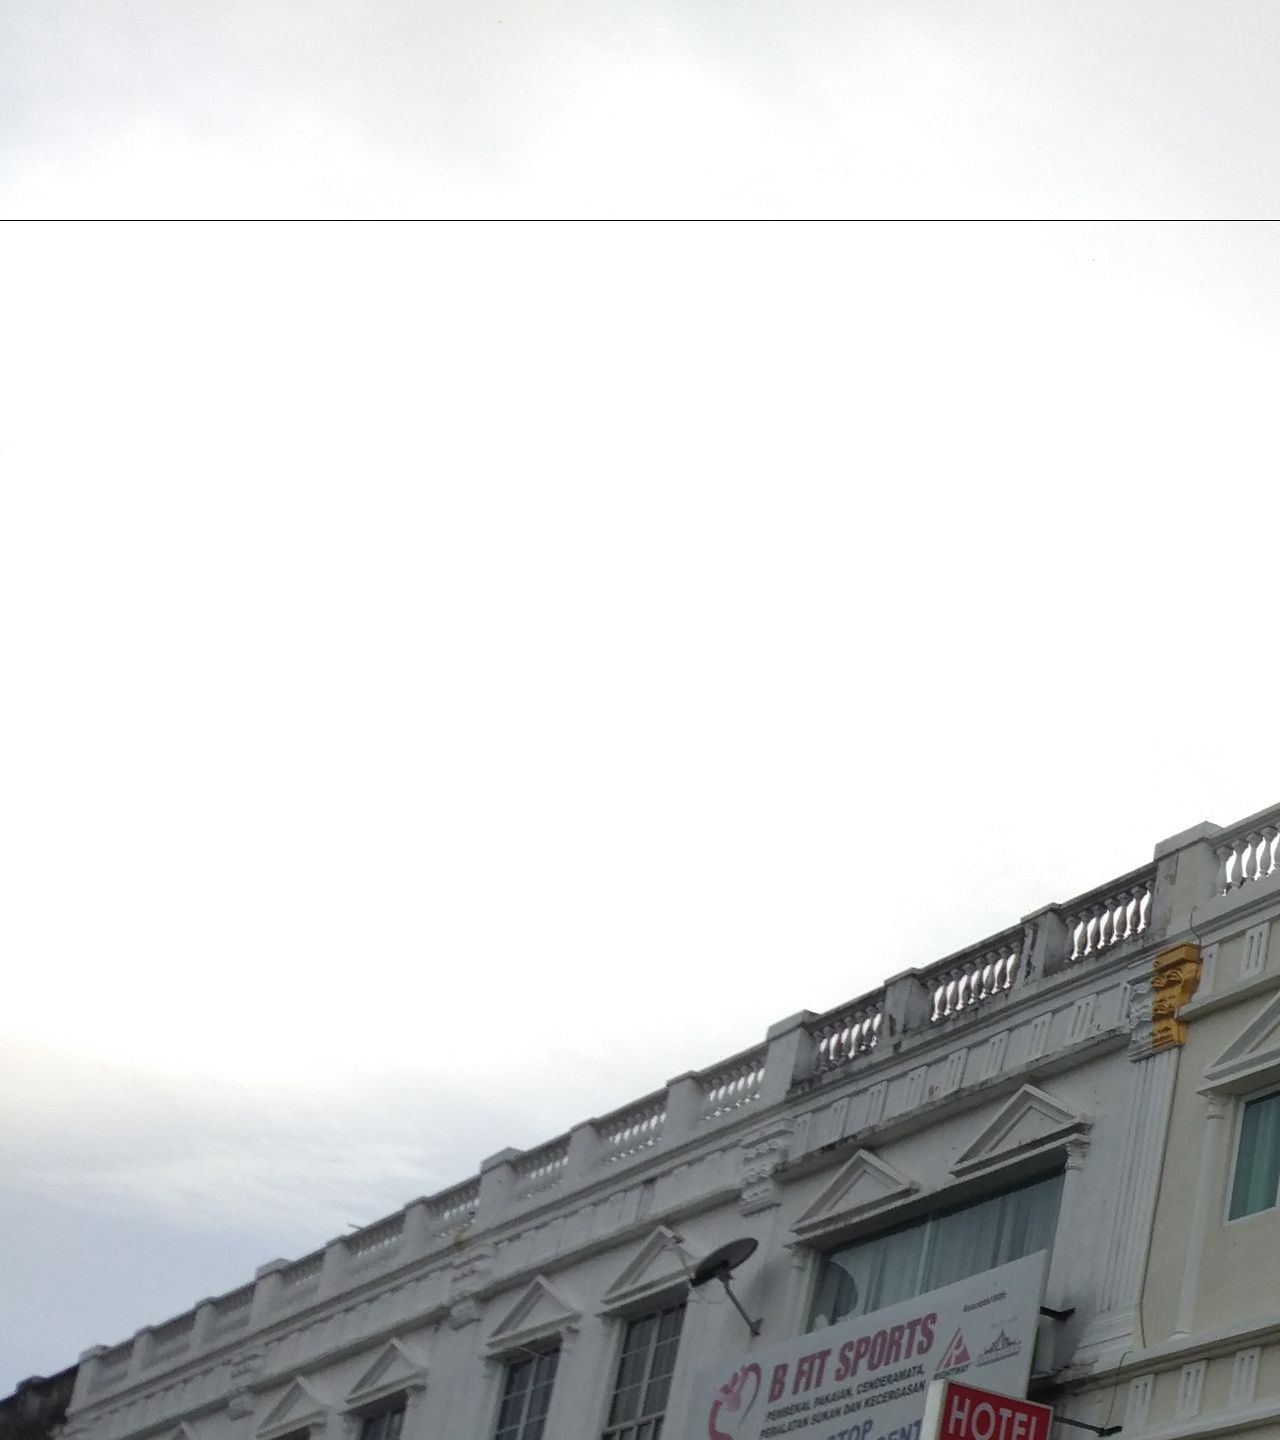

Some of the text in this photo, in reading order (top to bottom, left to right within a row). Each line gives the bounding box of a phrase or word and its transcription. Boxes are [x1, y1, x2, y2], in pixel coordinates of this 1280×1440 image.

[768, 1312, 938, 1404] B FIT SPORTS
[843, 1400, 863, 1415] DAN
